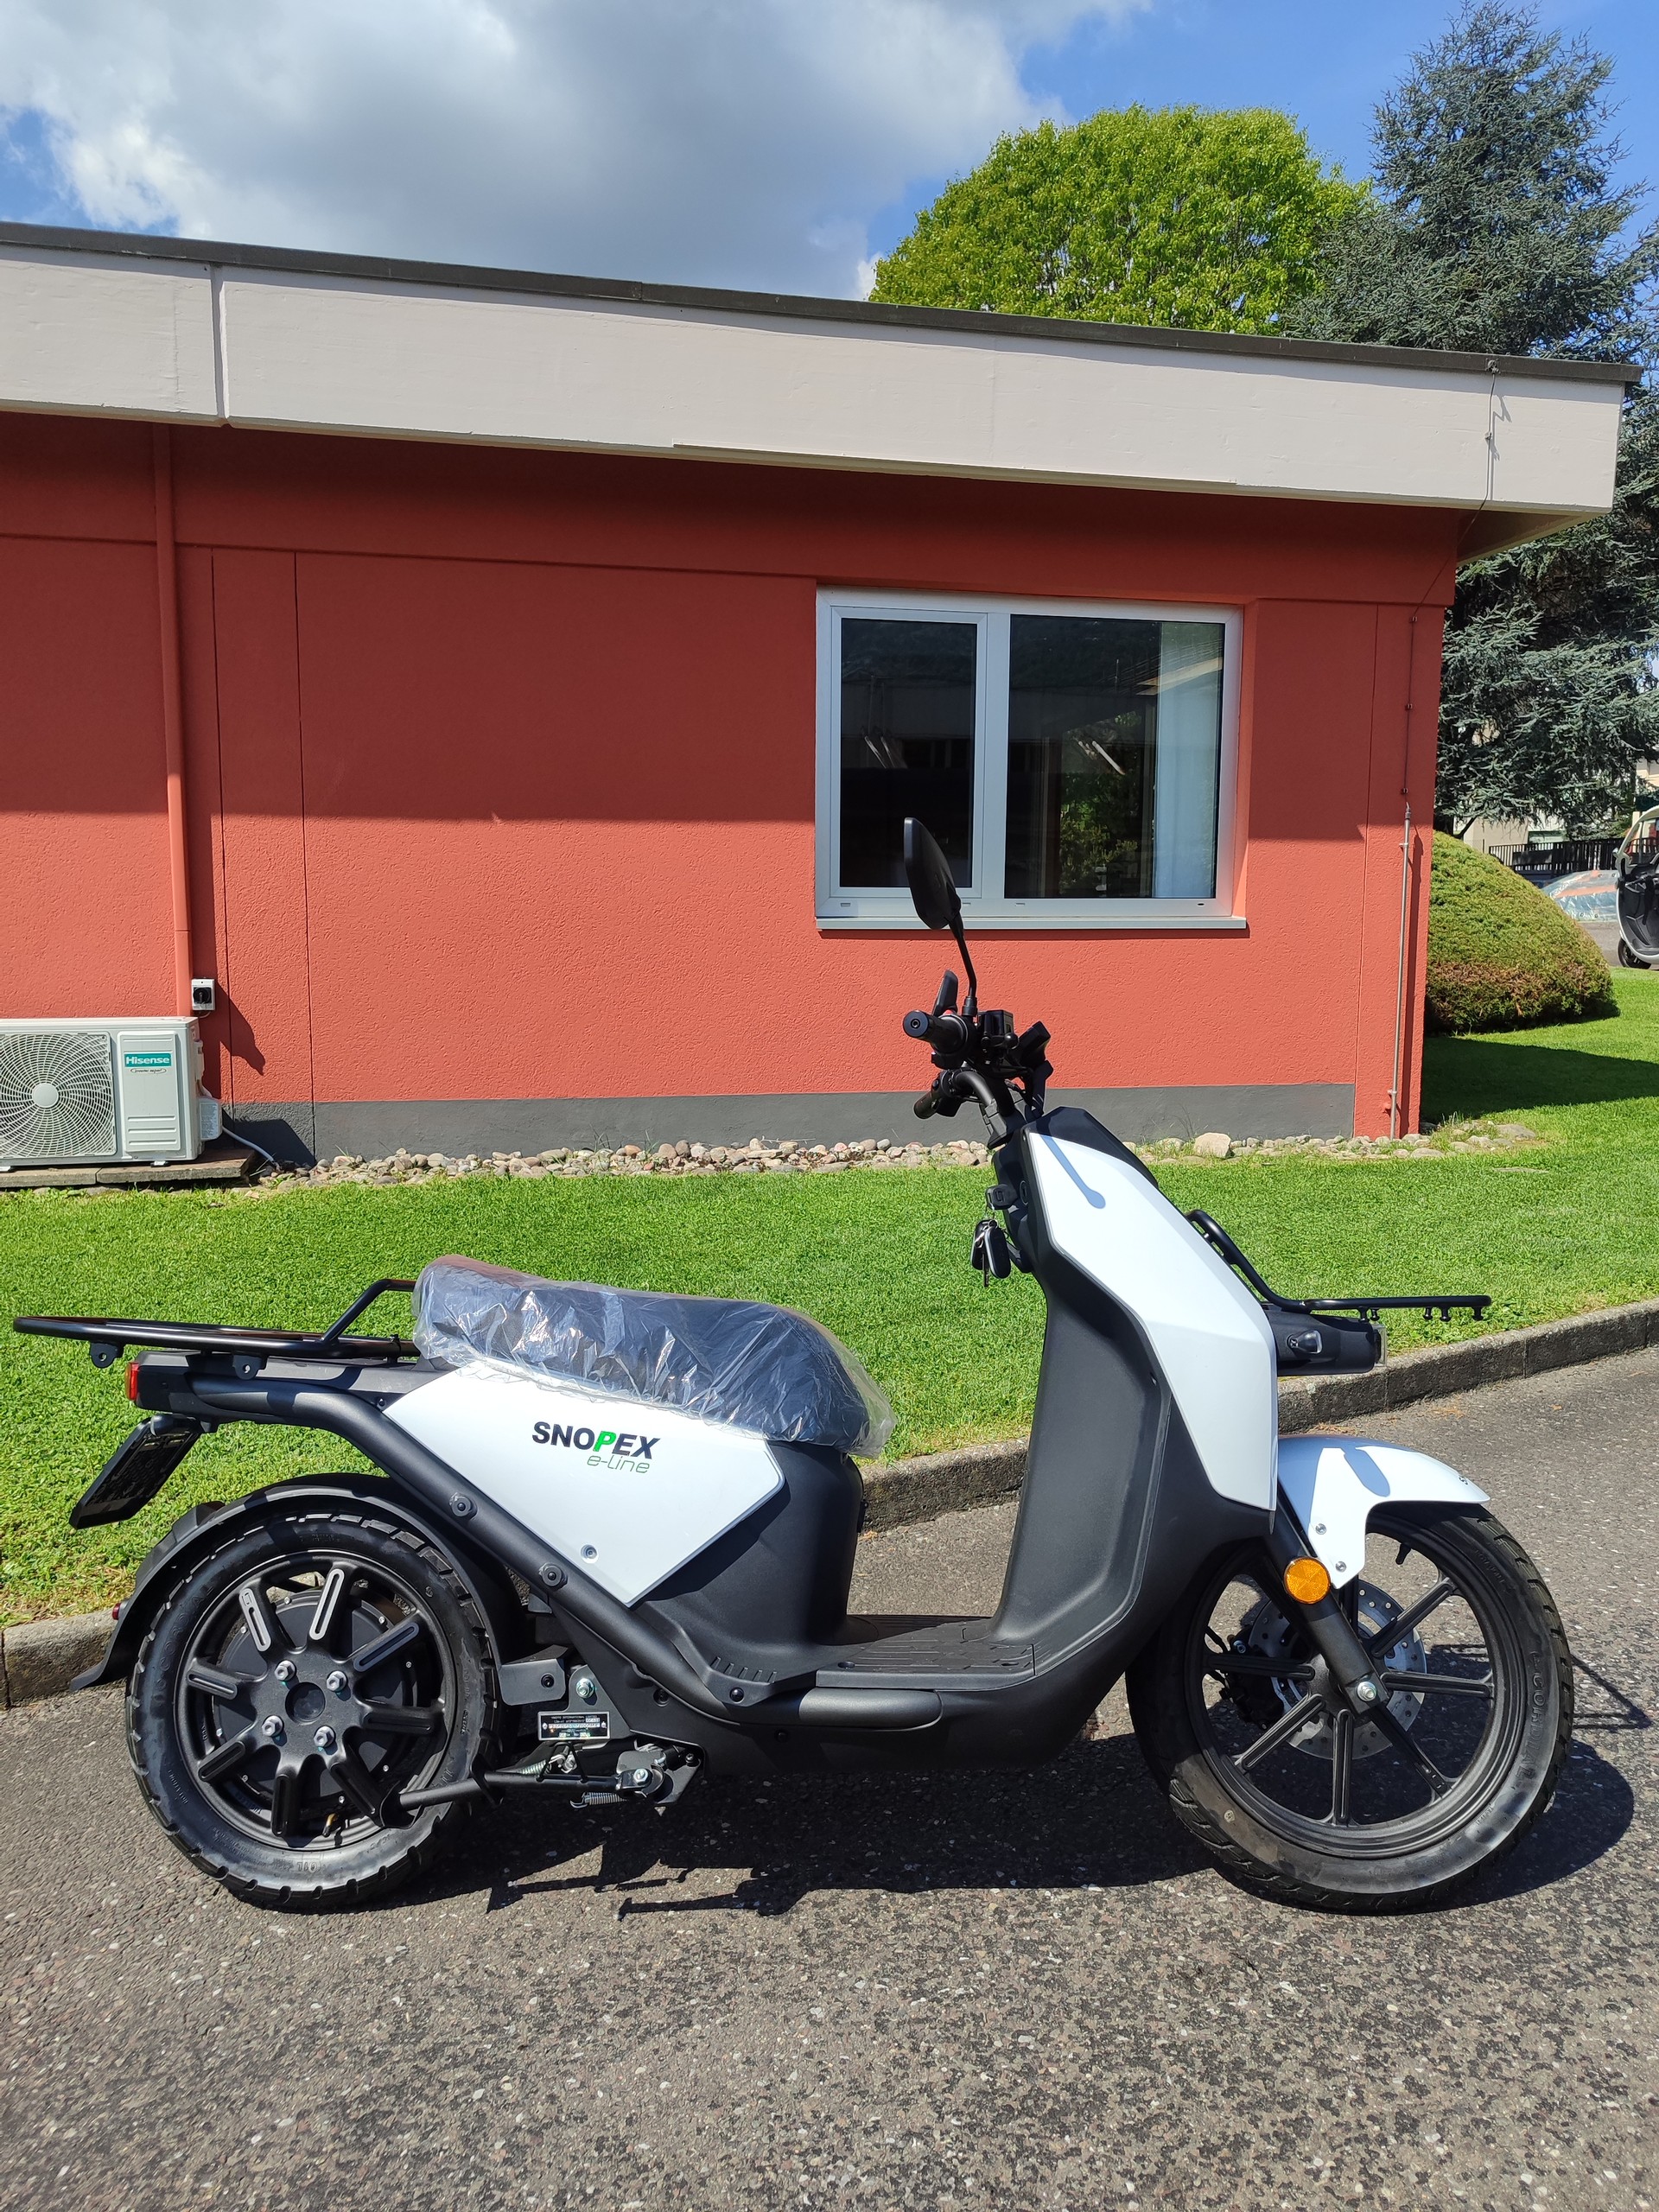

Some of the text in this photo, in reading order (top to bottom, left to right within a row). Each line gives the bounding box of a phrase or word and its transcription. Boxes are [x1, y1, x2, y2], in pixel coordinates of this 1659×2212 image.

[125, 1056, 170, 1065] Hisense
[531, 1421, 661, 1459] SNOPEX
[587, 1454, 650, 1473] e-line
